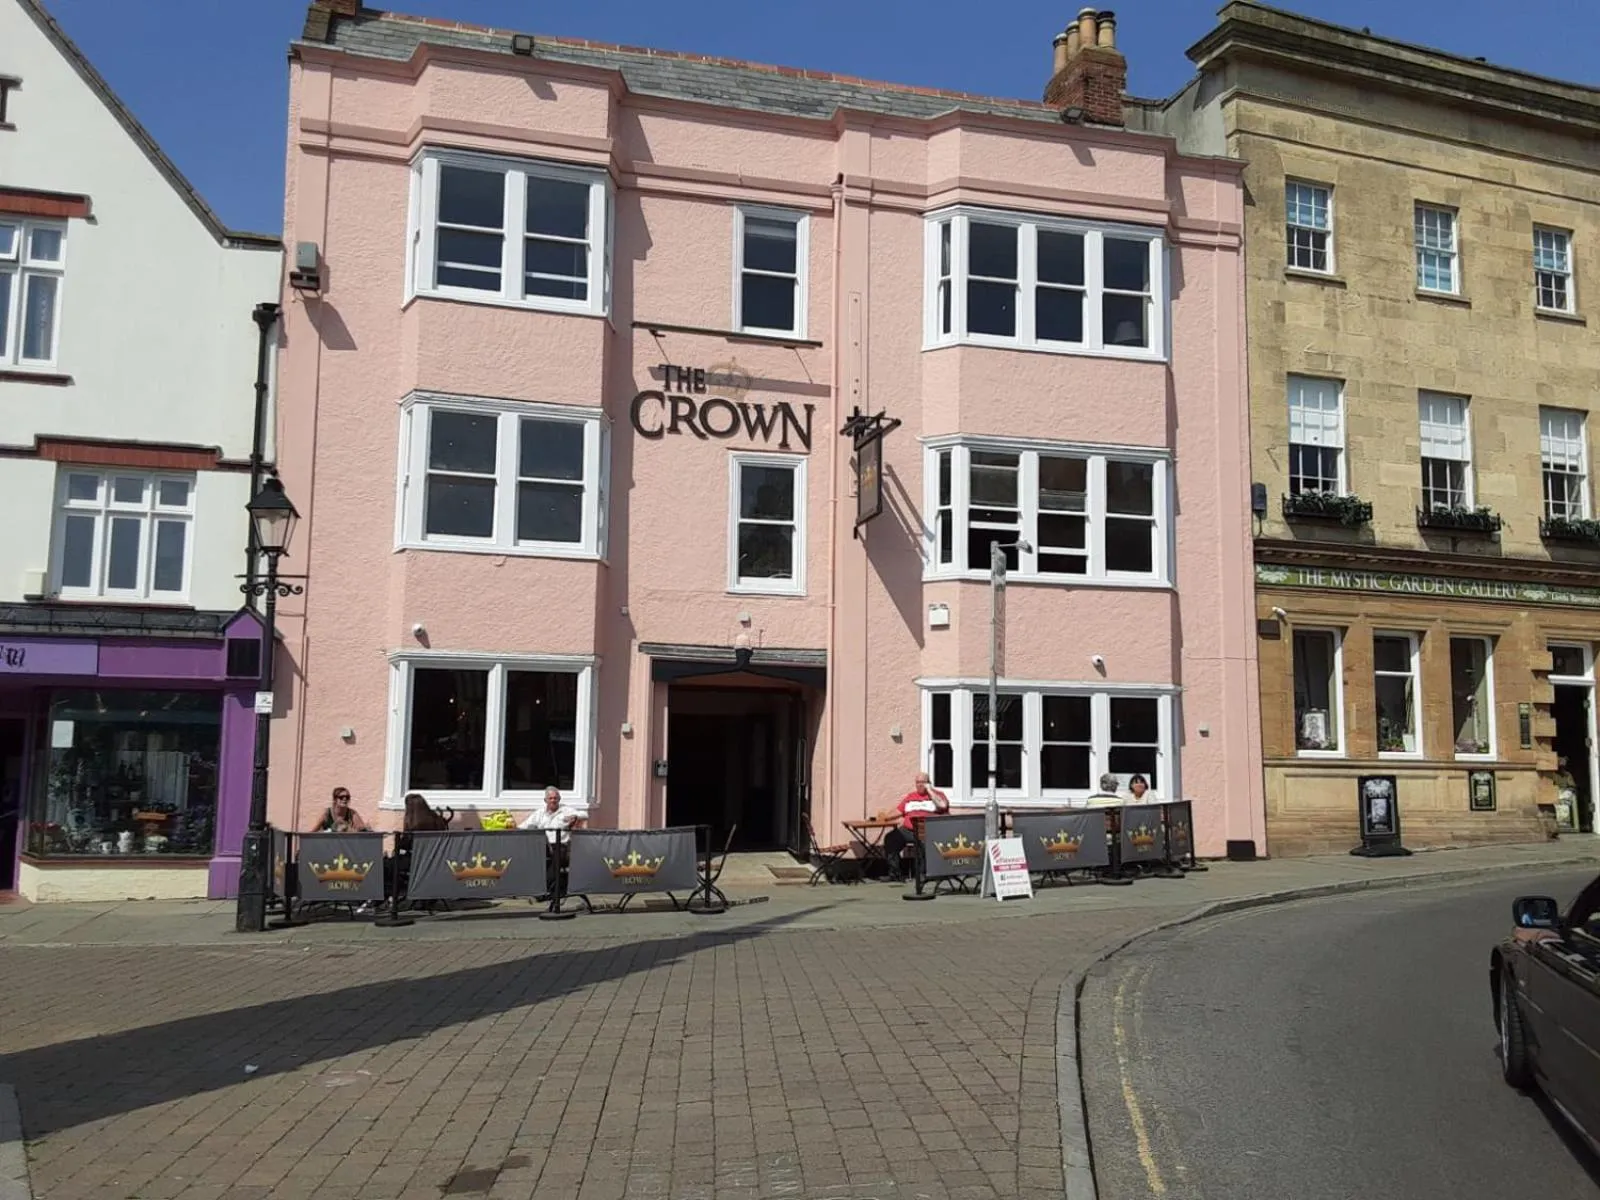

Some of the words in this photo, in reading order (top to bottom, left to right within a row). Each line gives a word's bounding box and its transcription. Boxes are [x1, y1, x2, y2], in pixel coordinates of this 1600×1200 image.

[659, 363, 706, 394] THE
[630, 390, 816, 450] CROWN
[1296, 568, 1325, 586] THE
[1330, 571, 1386, 590] MYSTIC
[1389, 574, 1454, 594] GARDEN
[1458, 579, 1517, 599] GALLERY
